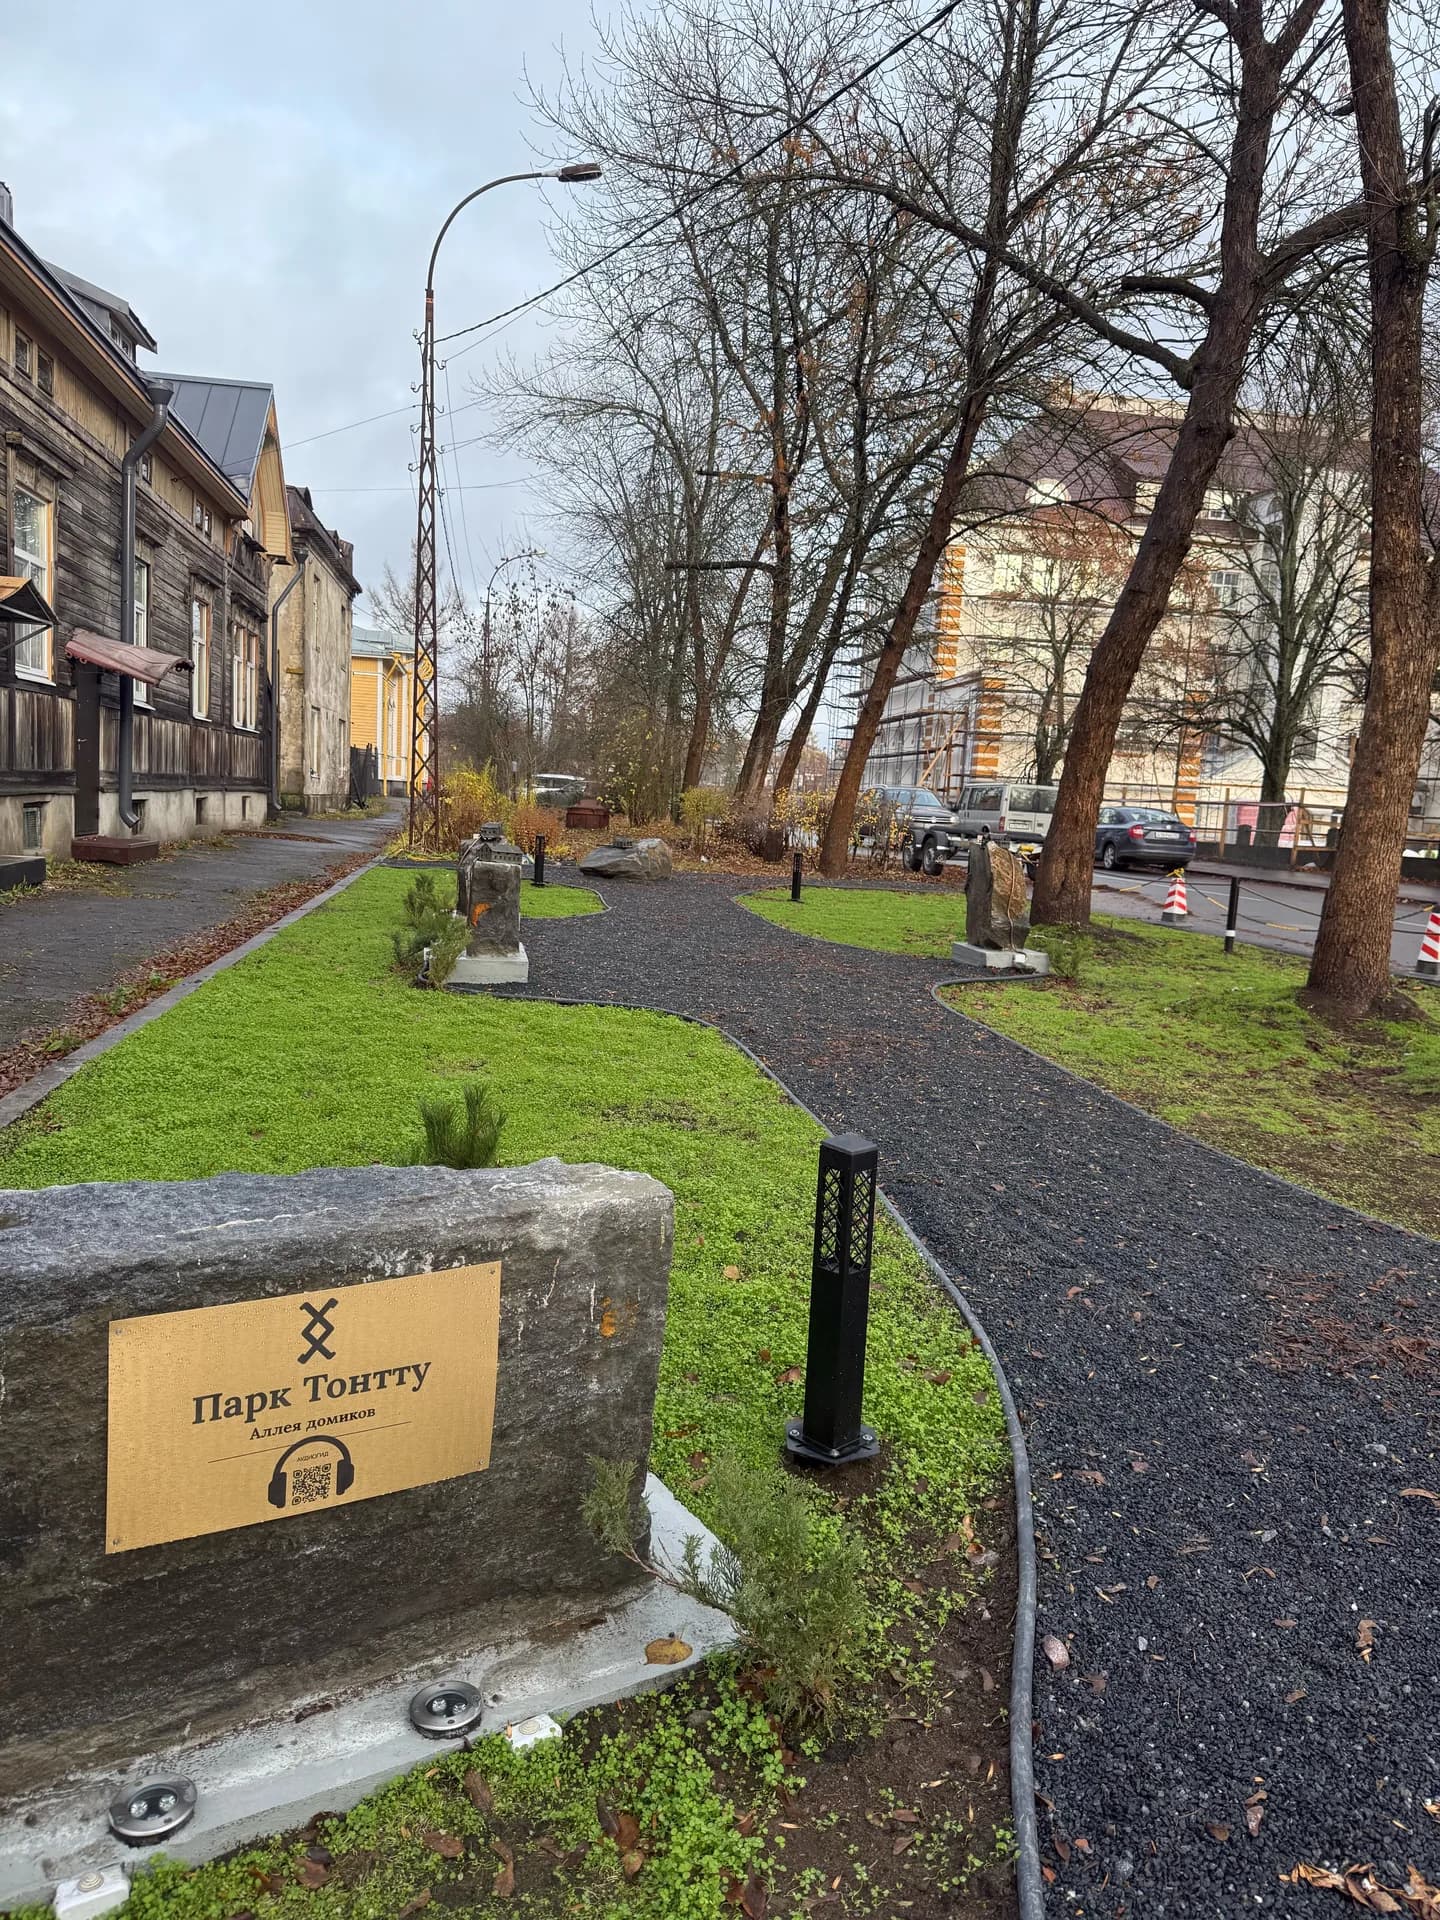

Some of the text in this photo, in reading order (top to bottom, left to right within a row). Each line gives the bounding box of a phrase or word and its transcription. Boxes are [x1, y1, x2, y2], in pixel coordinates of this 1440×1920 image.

[192, 1361, 432, 1425] Парк Тонтту
[249, 1408, 376, 1441] Аллея домиков
